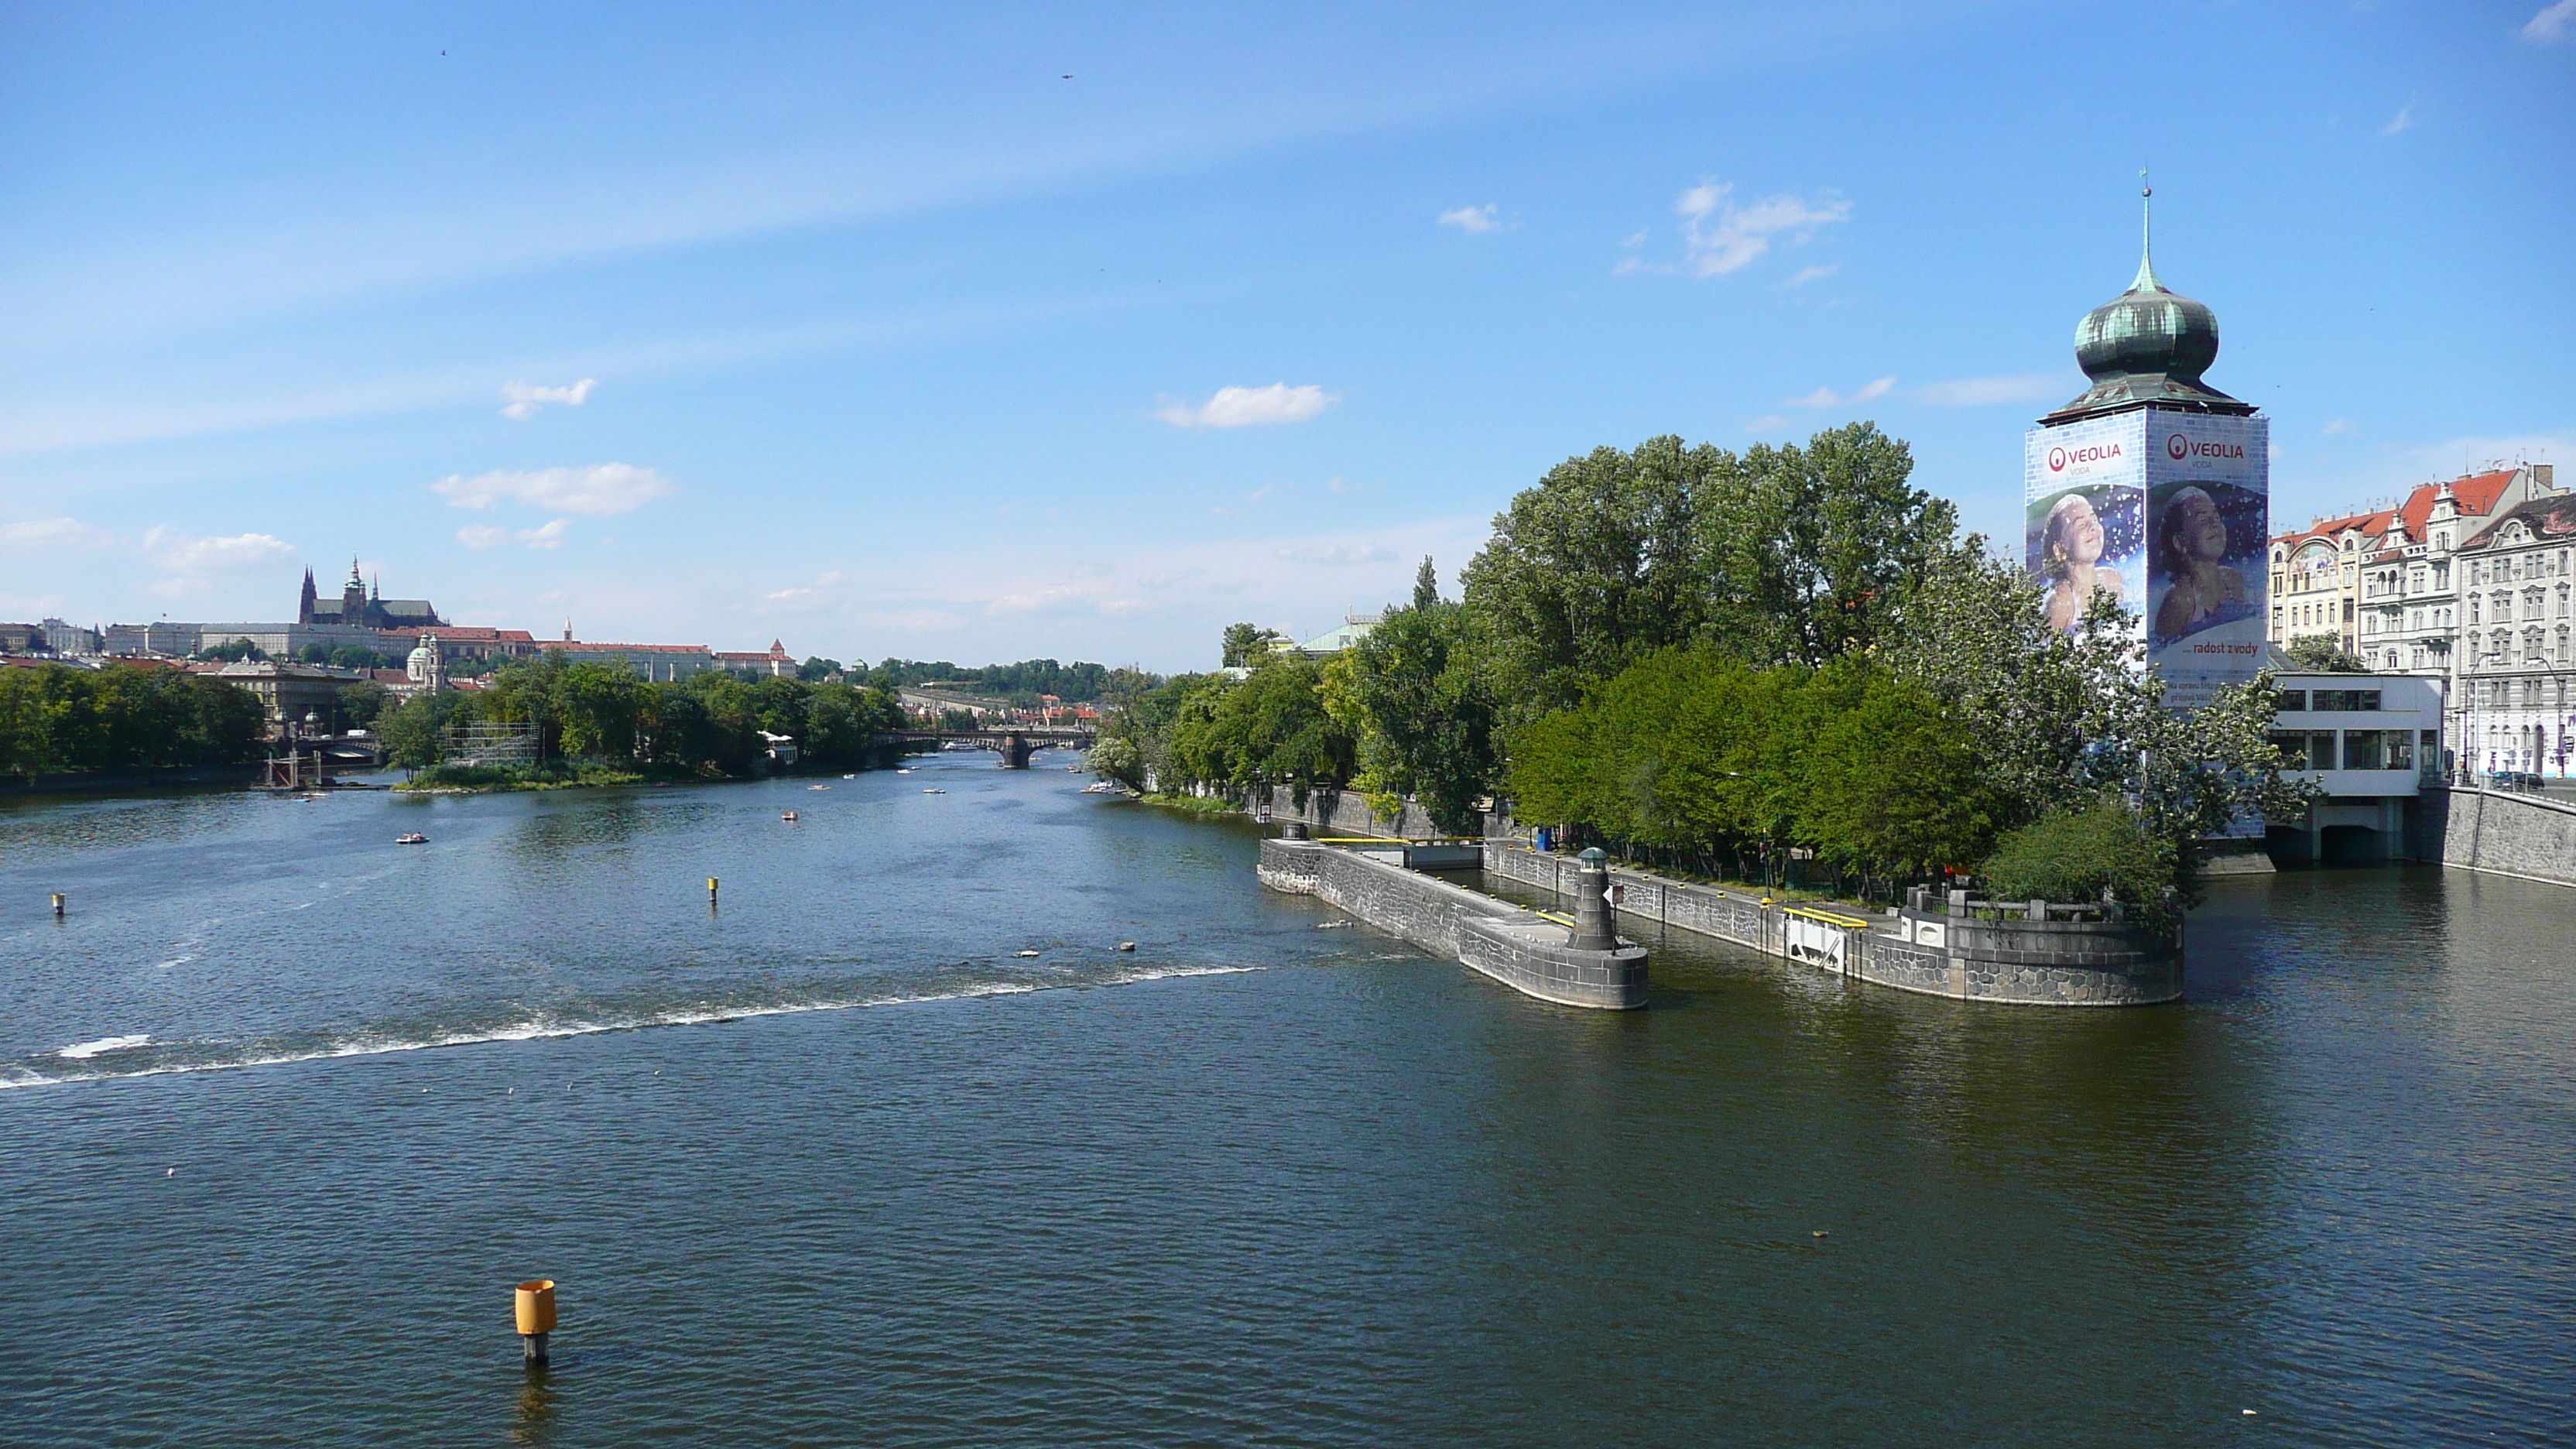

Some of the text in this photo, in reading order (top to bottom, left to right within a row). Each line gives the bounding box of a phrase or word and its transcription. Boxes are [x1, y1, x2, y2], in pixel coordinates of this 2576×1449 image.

[2068, 444, 2121, 464] VEOLIA
[2190, 442, 2244, 459] VEOLIA
[2070, 466, 2091, 476] VODA
[2191, 461, 2213, 469] VODA
[2194, 642, 2225, 654] radost
[2228, 645, 2233, 654] z
[2234, 642, 2258, 657] vody
